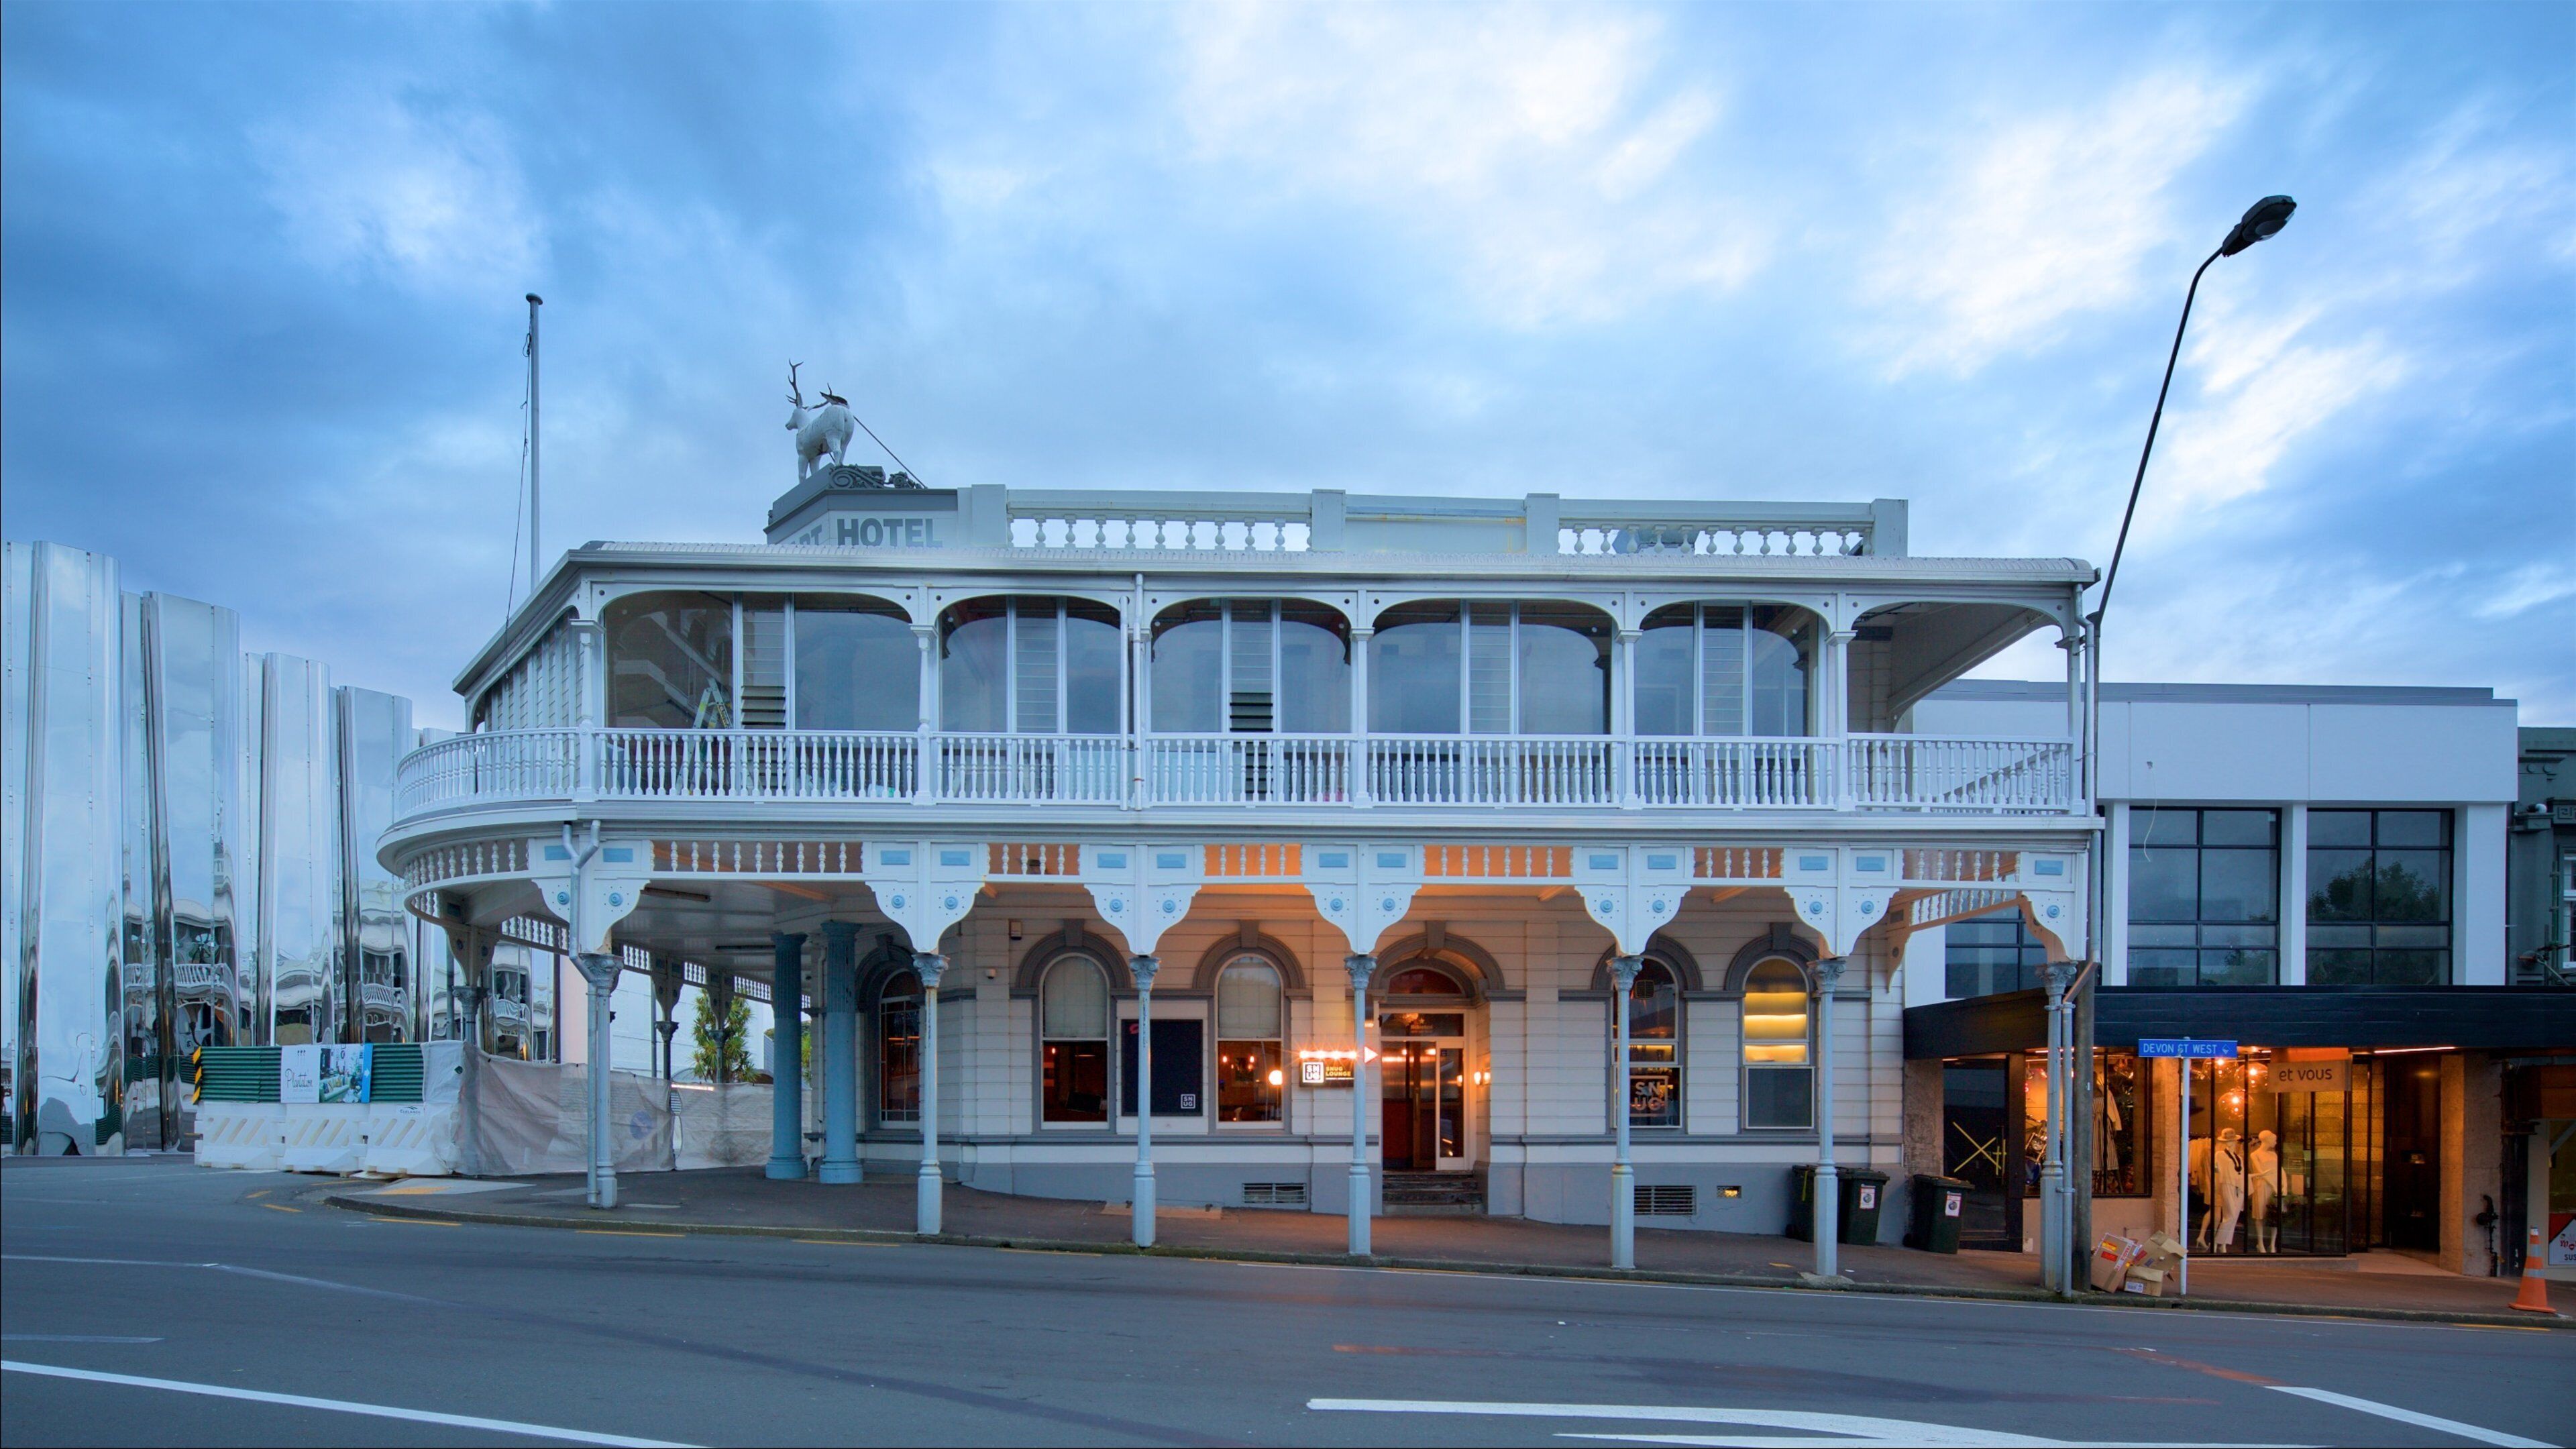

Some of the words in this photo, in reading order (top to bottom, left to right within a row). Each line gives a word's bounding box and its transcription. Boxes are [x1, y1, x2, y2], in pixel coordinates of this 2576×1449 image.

[837, 517, 943, 547] HOTEL
[2143, 1043, 2174, 1053] DEVON
[2178, 1044, 2189, 1054] ST
[2192, 1044, 2217, 1054] WEST
[2278, 1068, 2293, 1081] et
[2297, 1068, 2332, 1081] vous
[1635, 1081, 1662, 1096] SN
